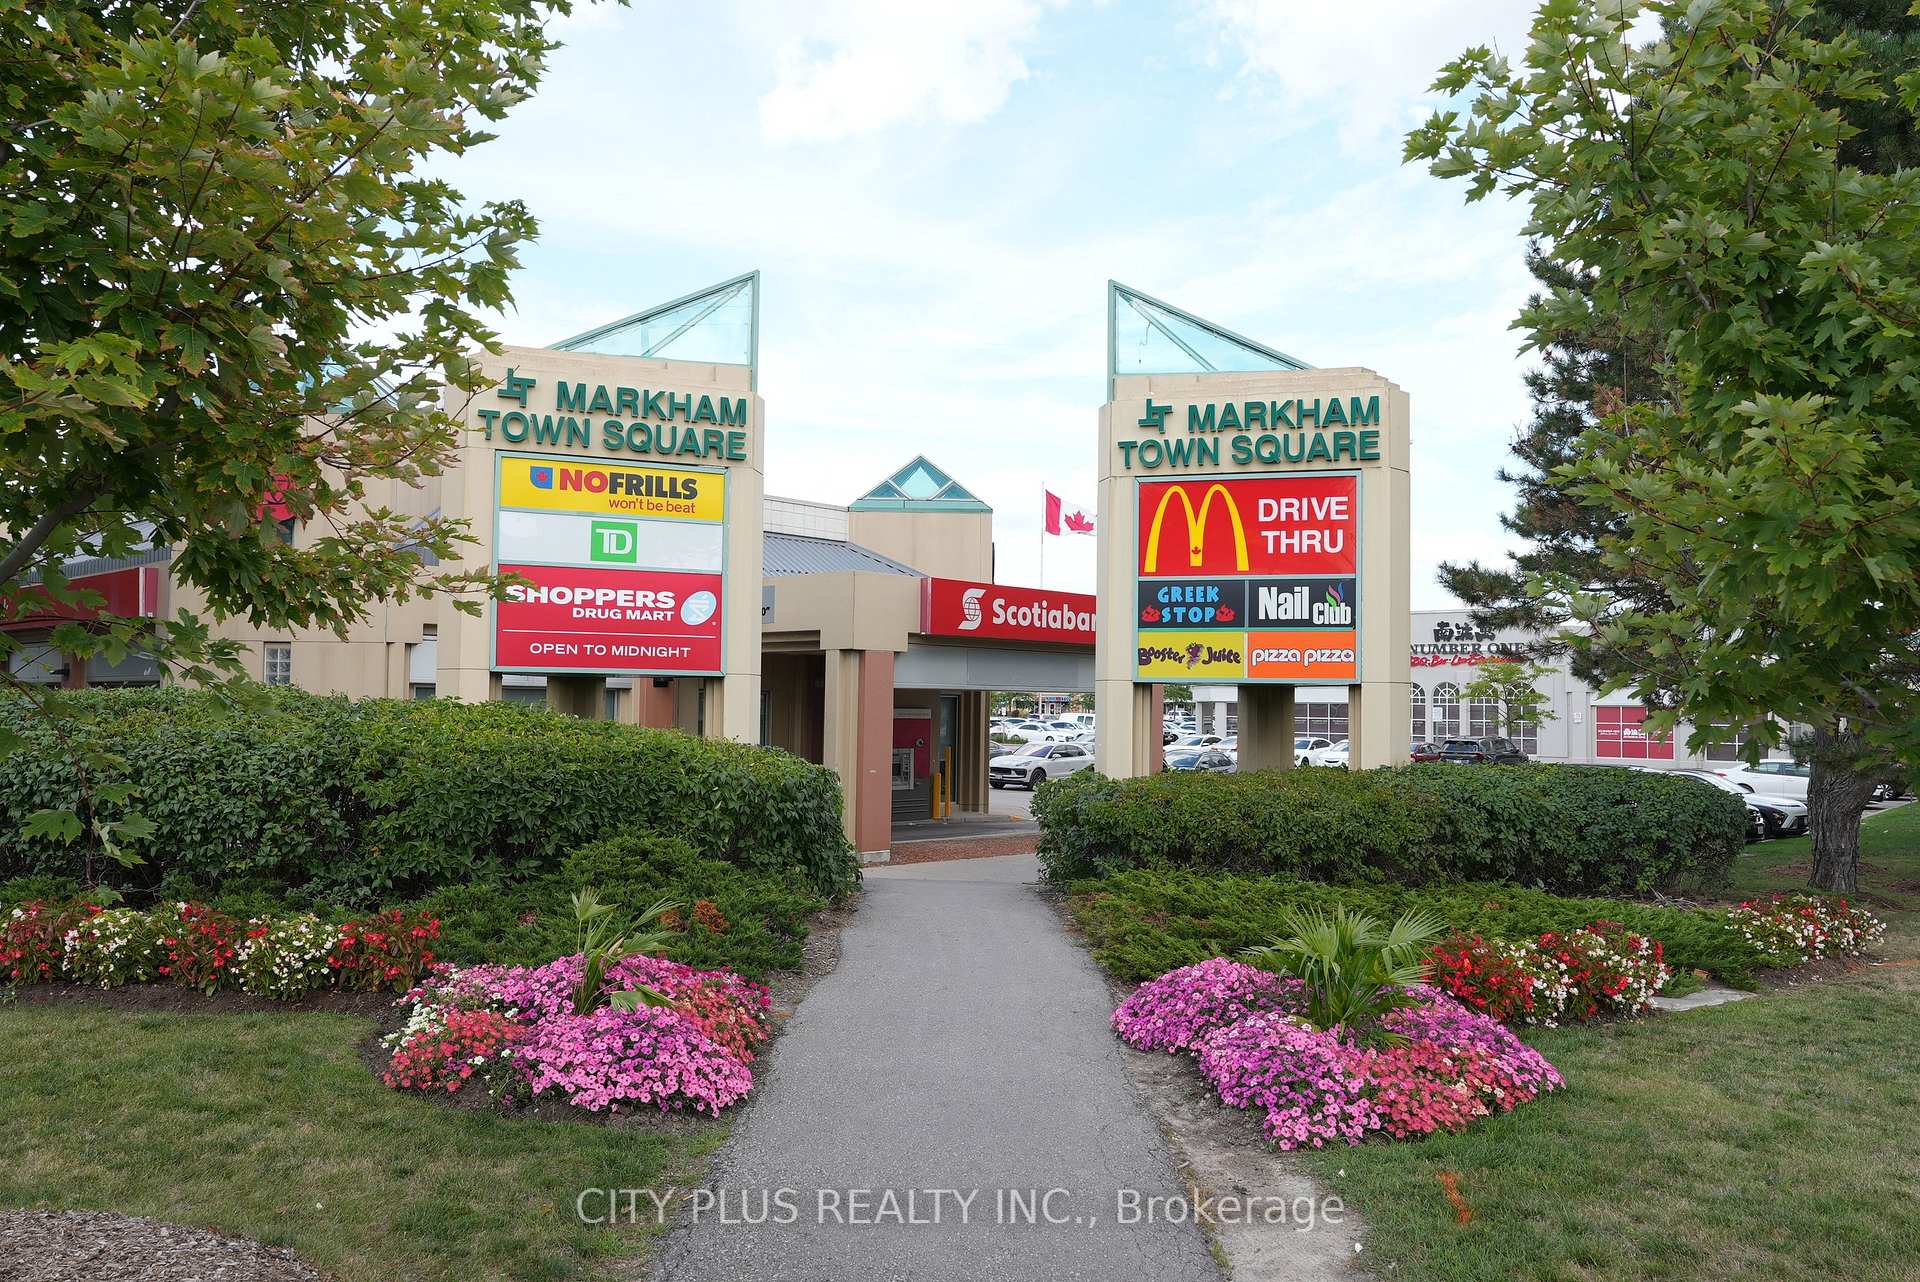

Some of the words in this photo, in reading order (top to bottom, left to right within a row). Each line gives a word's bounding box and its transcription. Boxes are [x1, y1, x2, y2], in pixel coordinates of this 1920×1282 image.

[556, 380, 747, 427] MARKHAM
[1188, 395, 1381, 434] MARKHAM
[478, 409, 591, 448] TOWN
[603, 419, 748, 460] SQUARE
[1118, 436, 1220, 469] TOWN
[1231, 430, 1381, 464] SQUARE
[609, 498, 645, 510] won't
[646, 499, 664, 512] be
[666, 501, 696, 514] beat
[1258, 496, 1349, 522] DRIVE
[595, 528, 633, 555] TD
[1261, 529, 1344, 554] THRU
[506, 584, 676, 608] SHOPPERS
[1157, 585, 1220, 603] GREEK
[1258, 586, 1310, 620] Nail
[572, 607, 622, 620] DRUG
[626, 609, 675, 622] MART
[1161, 606, 1216, 623] STOP
[1312, 602, 1352, 625] Club
[529, 642, 578, 655] OPEN
[583, 644, 607, 656] TO
[611, 645, 691, 658] MIDNIGHT
[1138, 646, 1186, 666] Booster
[1201, 646, 1241, 665] Juice
[1410, 643, 1482, 655] NUMBER
[1487, 642, 1525, 656] ONE
